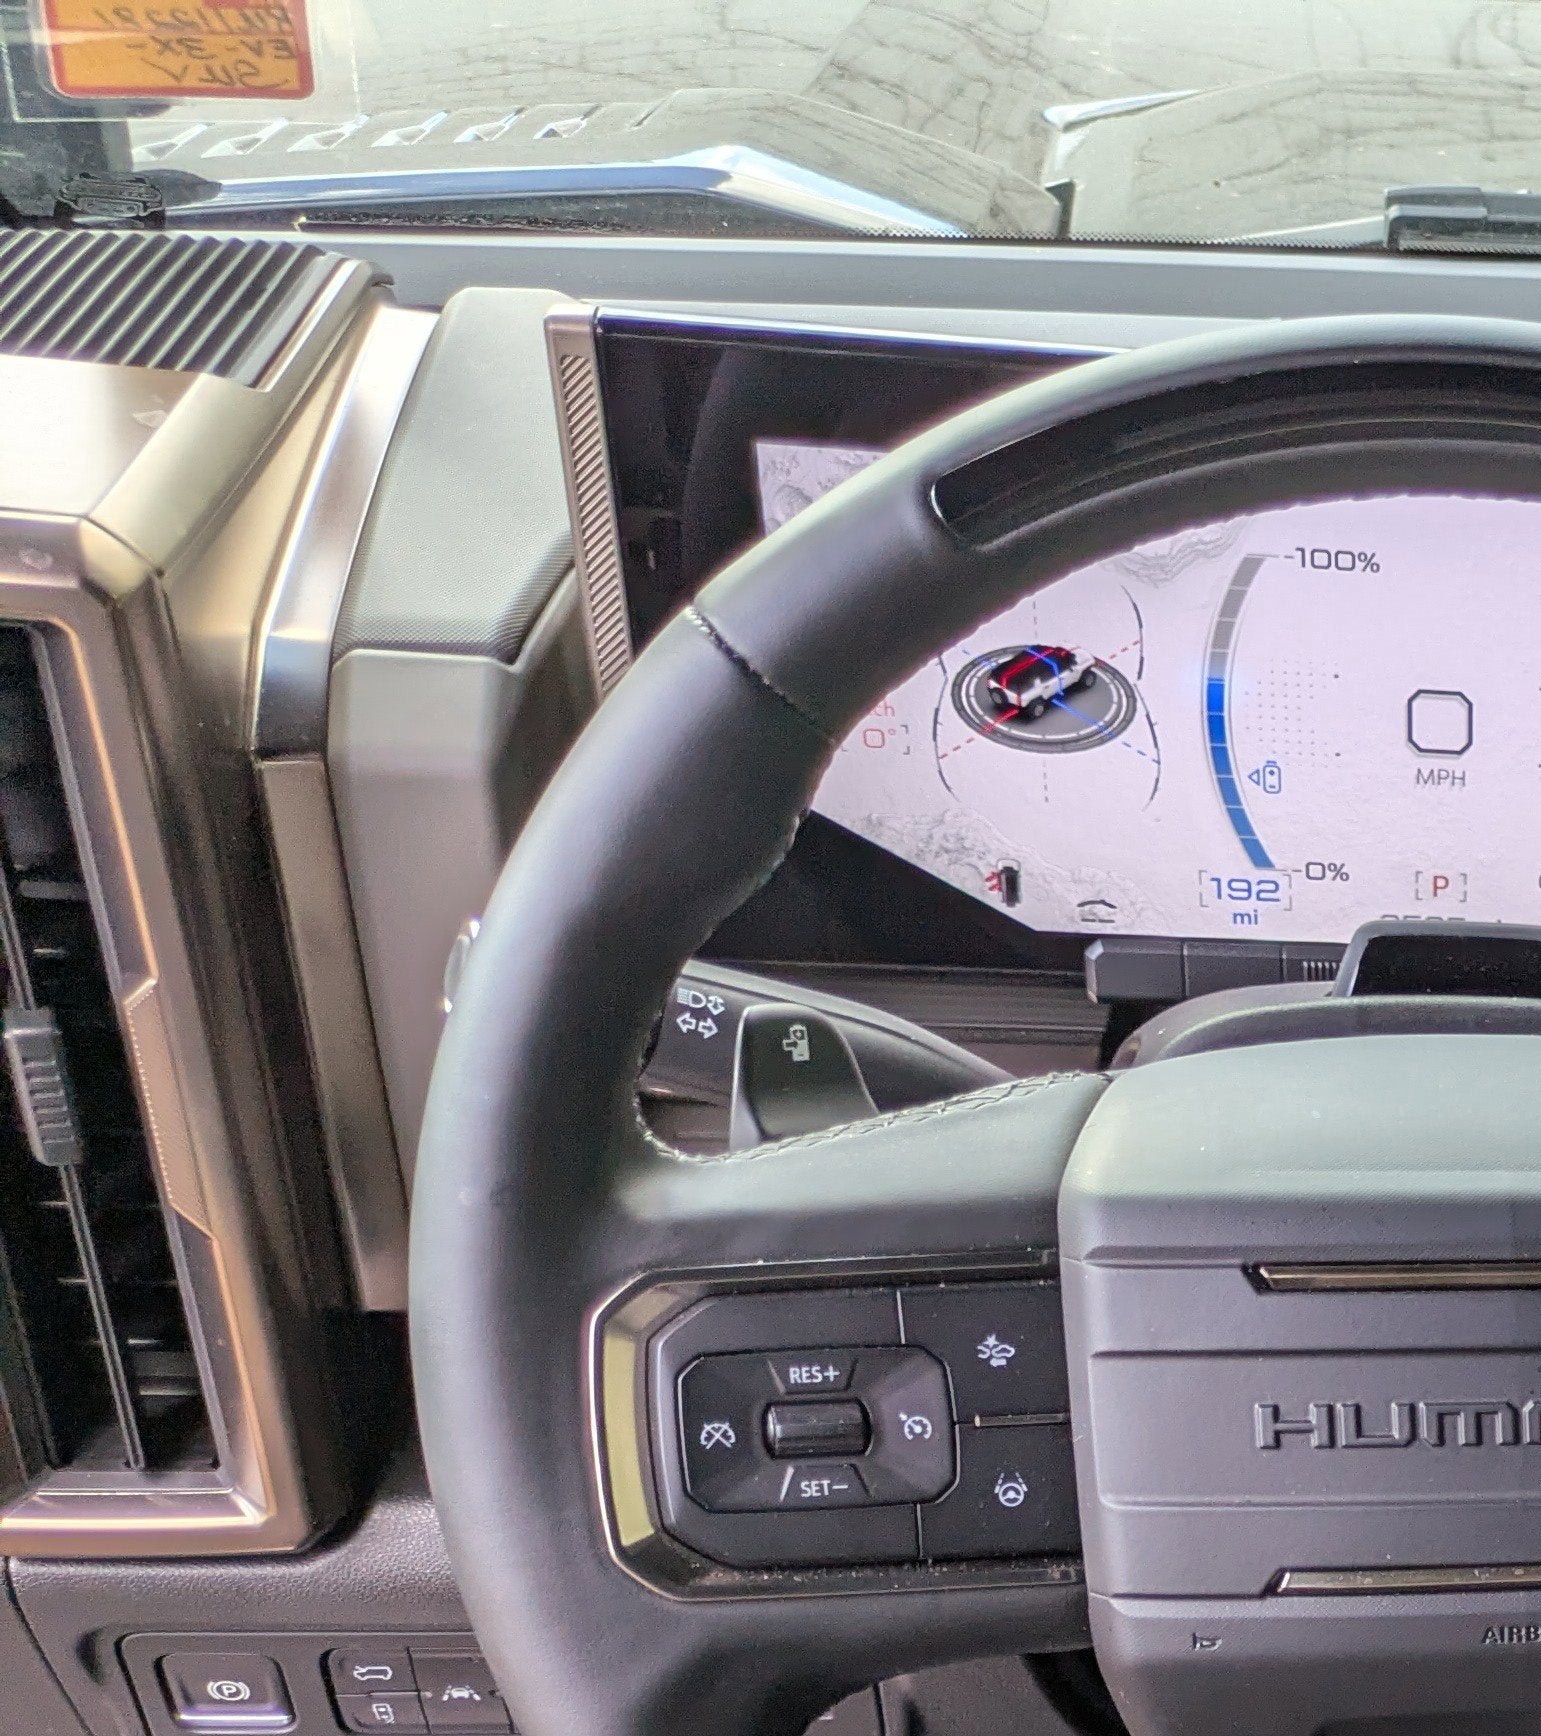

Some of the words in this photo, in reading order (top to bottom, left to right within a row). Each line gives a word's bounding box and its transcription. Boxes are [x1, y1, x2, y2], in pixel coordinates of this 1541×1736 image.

[1415, 767, 1467, 788] MPH
[1209, 876, 1282, 903] 192
[1431, 876, 1449, 898] P
[1232, 907, 1259, 926] mi
[789, 1366, 839, 1384] RES+
